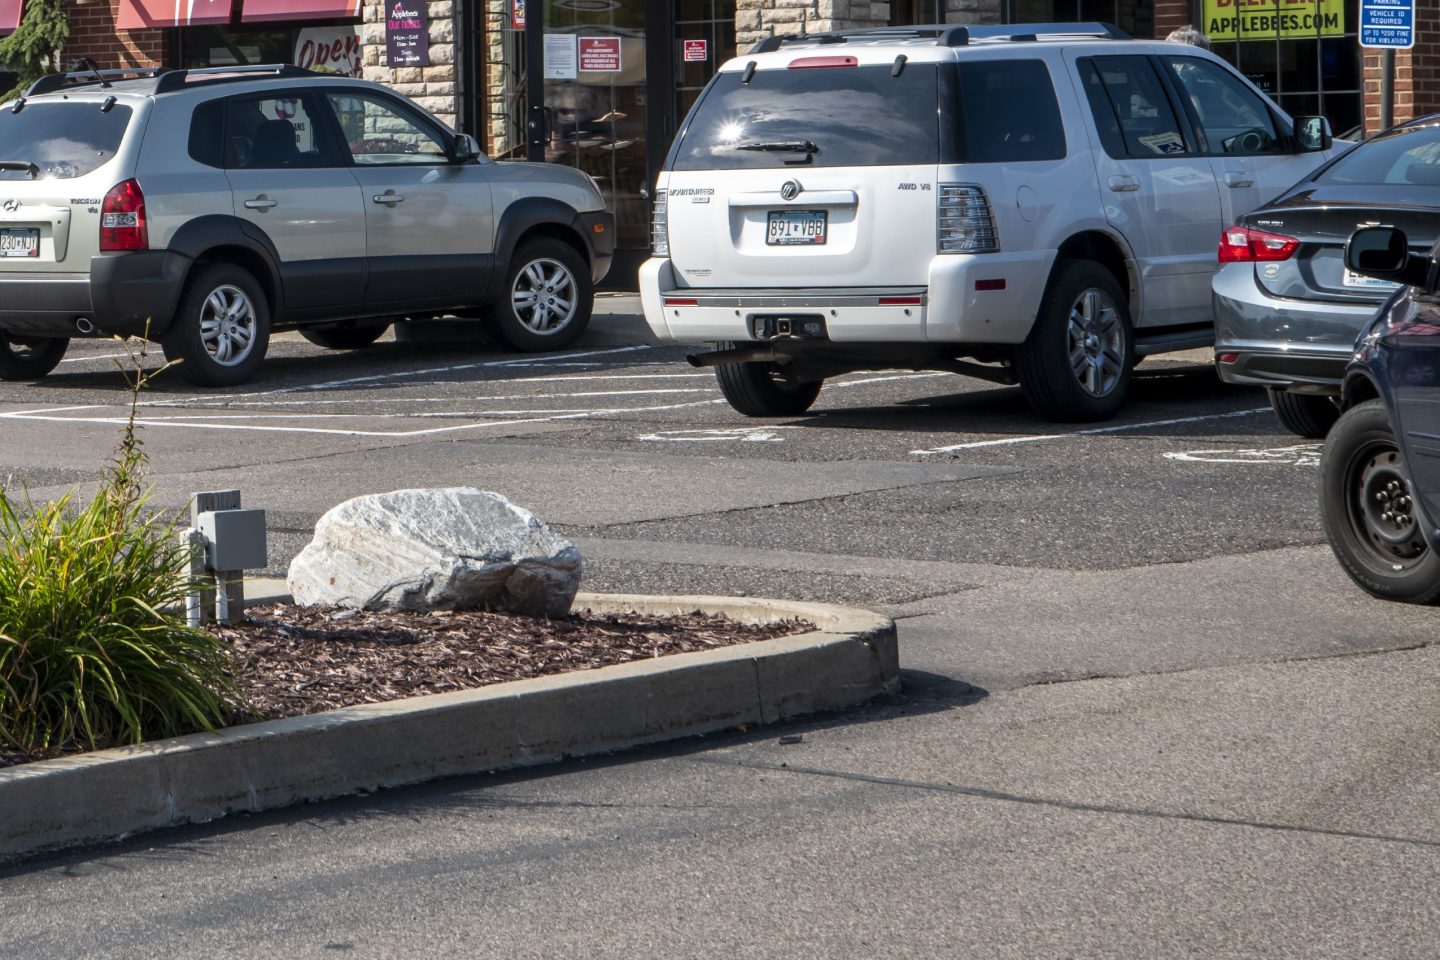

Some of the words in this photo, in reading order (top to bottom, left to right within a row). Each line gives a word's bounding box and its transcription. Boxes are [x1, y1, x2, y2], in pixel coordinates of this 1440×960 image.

[388, 20, 400, 30] Our
[1209, 13, 1339, 33] APPLEBEES.COM
[898, 183, 917, 191] AWD
[770, 221, 792, 236] 891
[802, 220, 823, 236] VBB
[1, 236, 17, 250] 230
[21, 235, 36, 250] NJY
